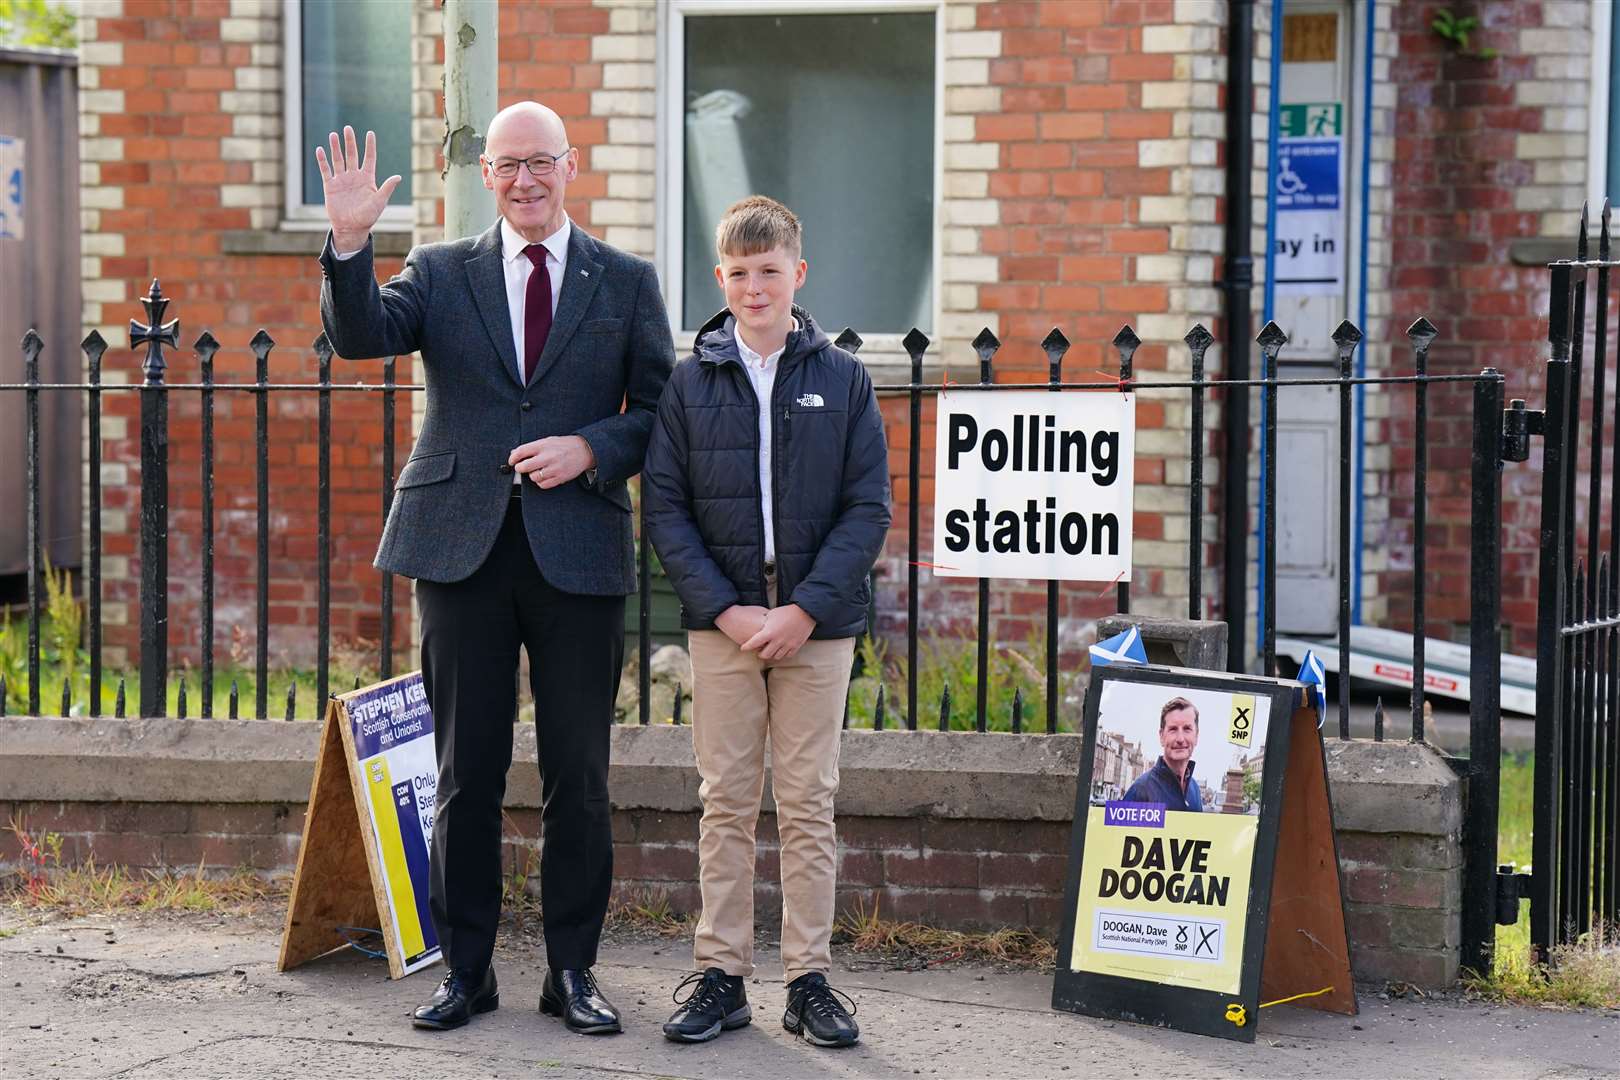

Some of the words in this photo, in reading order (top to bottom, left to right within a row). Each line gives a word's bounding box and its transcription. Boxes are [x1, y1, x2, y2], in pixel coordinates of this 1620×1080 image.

[1314, 233, 1335, 253] in
[948, 413, 1119, 487] Polling
[945, 497, 1119, 556] station
[354, 690, 406, 723] STEPHEN
[363, 716, 390, 736] Scottish
[380, 728, 394, 744] and
[394, 720, 423, 739] Unionist
[1232, 730, 1249, 740] SNP
[396, 785, 409, 796] CON
[415, 773, 437, 791] Only
[1109, 807, 1138, 821] VOTE
[1139, 809, 1161, 823] FOR
[1120, 835, 1212, 873] DAVE
[1098, 868, 1231, 907] DOOGAN
[1103, 921, 1144, 936] DOOGAN,
[1146, 925, 1168, 937] Dave
[1121, 935, 1141, 943] National
[1141, 938, 1154, 946] Party
[1154, 939, 1168, 947] (SNP)
[1174, 943, 1188, 951] SNP
